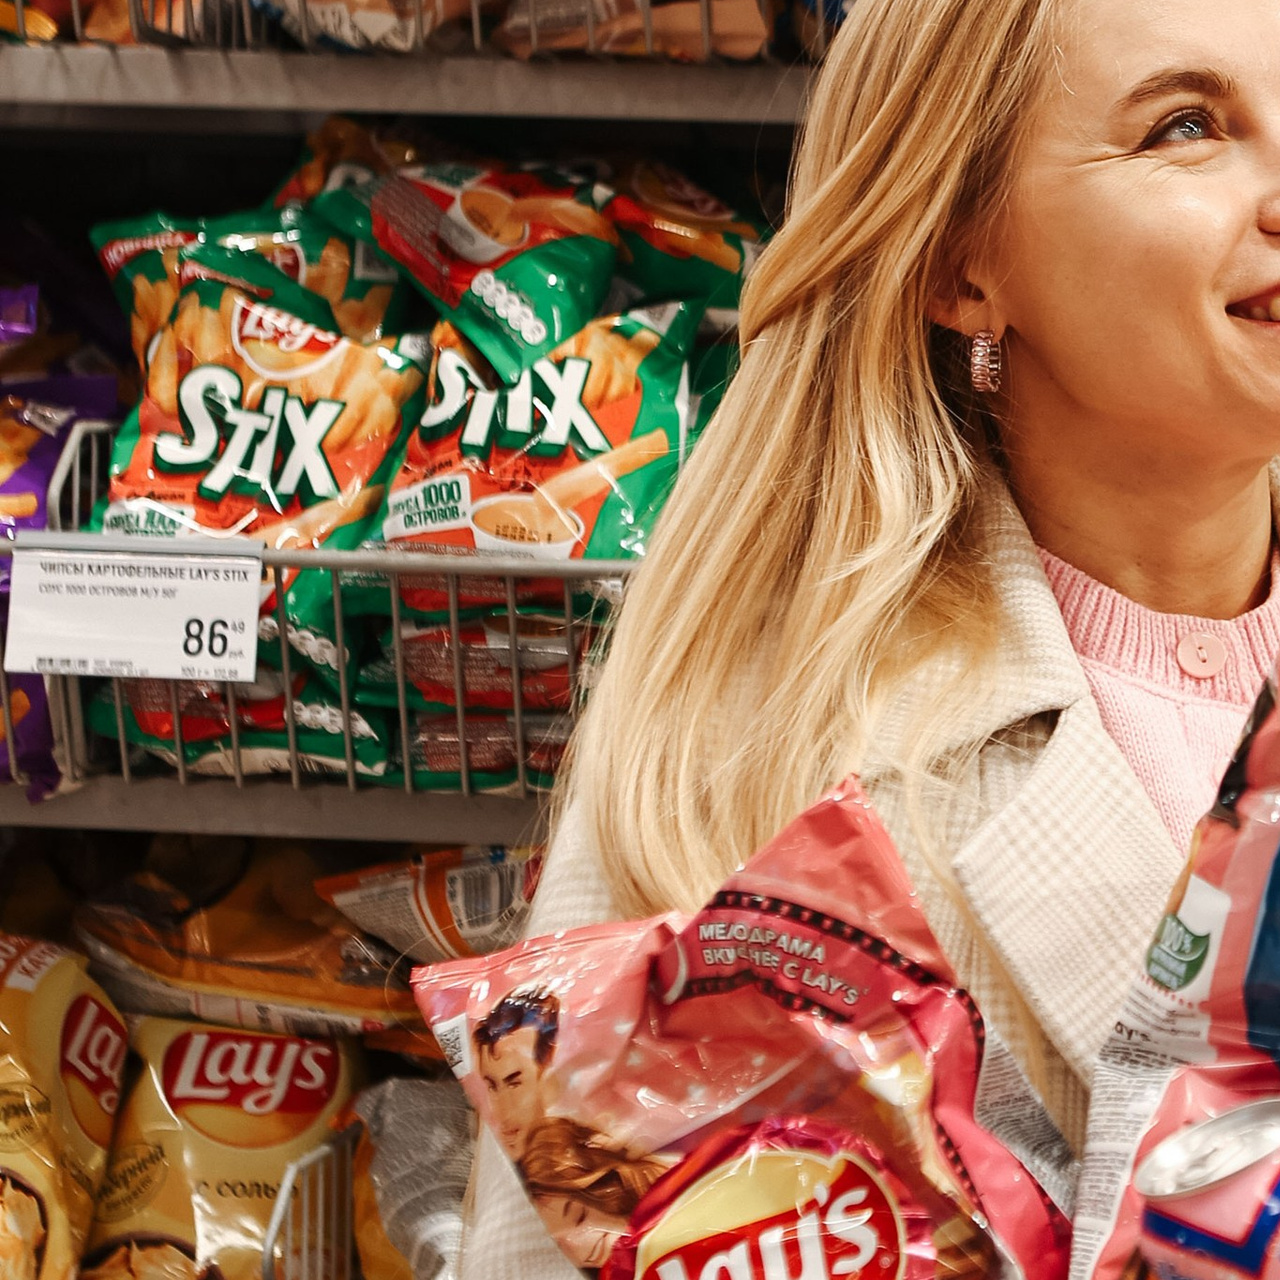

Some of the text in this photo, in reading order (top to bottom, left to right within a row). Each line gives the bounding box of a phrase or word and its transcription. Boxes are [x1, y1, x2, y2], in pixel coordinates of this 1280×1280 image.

[422, 479, 463, 509] 1000
[40, 560, 250, 583] ЧИПСЫ КАРТОФЕЛЬНЫЕ LAY'S STIX
[183, 618, 229, 658] 86
[231, 620, 245, 633] 49
[699, 922, 825, 965] МЕЛОДРАМА
[801, 968, 859, 1006] LAY'S
[171, 1031, 332, 1117] Lay's
